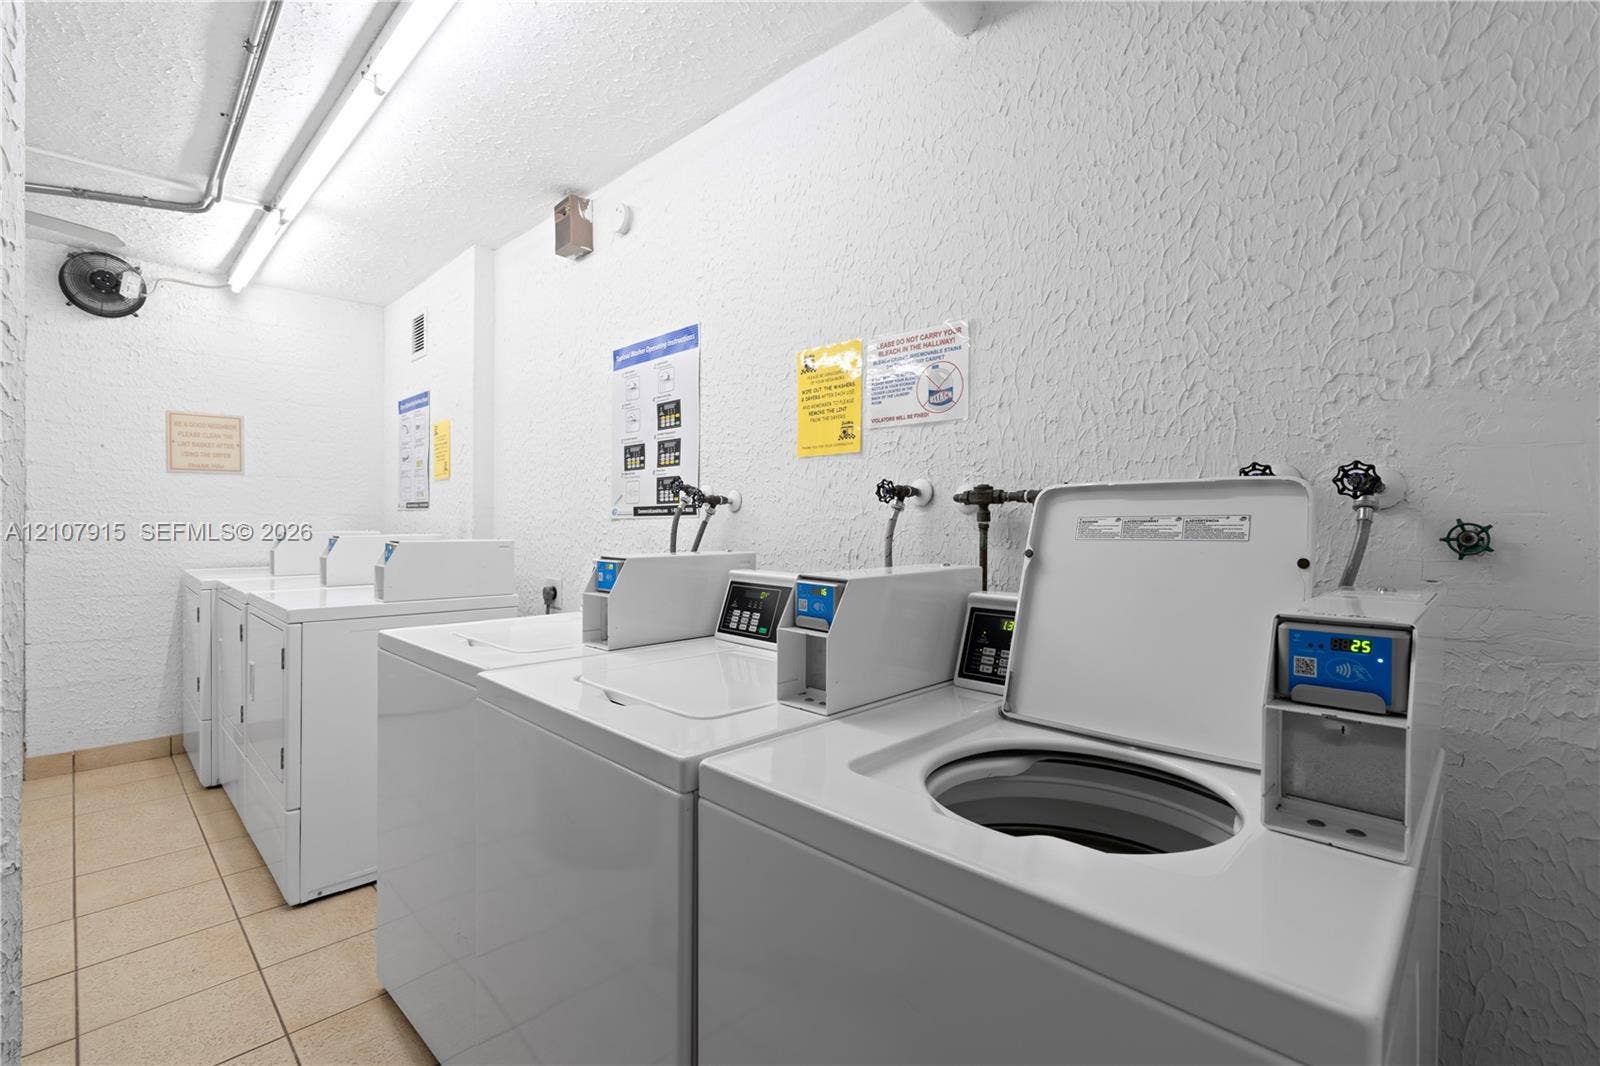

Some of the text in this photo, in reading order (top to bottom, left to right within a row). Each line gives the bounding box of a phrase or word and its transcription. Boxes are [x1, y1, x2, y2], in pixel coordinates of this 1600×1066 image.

[906, 336, 918, 344] NOT
[920, 330, 942, 341] CARRY
[943, 326, 962, 336] YOUR
[646, 342, 667, 353] Operating
[667, 334, 696, 346] Instructions
[878, 348, 901, 358] BLEACH
[922, 336, 956, 348] HALLWAY!
[944, 345, 962, 353] STAINS
[834, 381, 855, 390] WASHERS
[1350, 639, 1372, 654] 25
